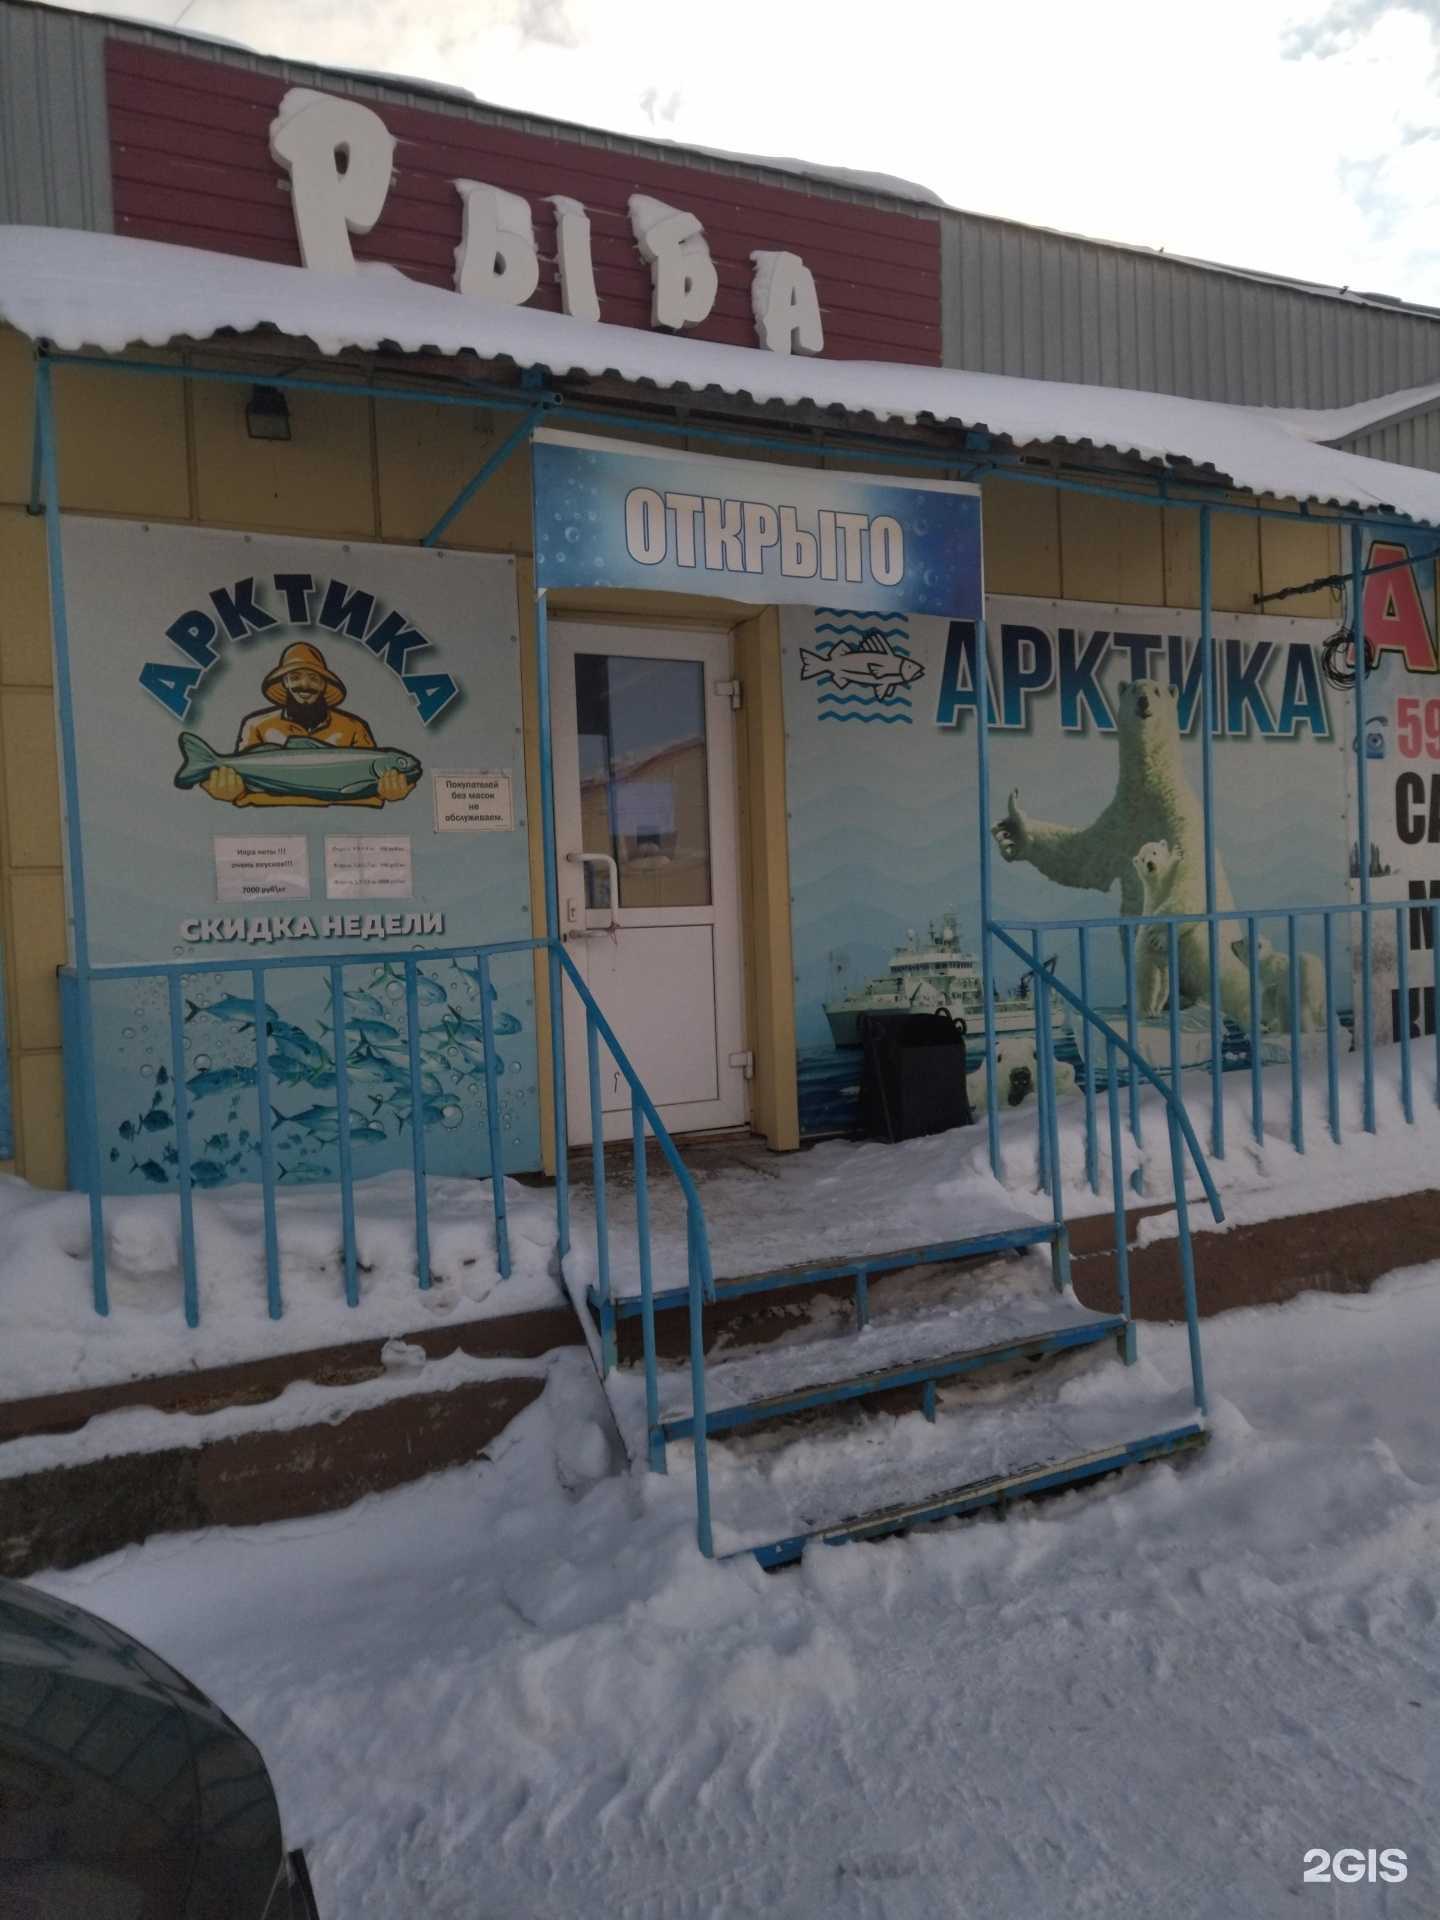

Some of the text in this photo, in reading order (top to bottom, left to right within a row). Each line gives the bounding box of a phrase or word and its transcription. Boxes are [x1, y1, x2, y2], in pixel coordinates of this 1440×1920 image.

[624, 486, 905, 587] ОТКРЫТО
[138, 573, 462, 725] АРКТИКА
[935, 619, 1331, 738] АРКТИКА
[446, 779, 499, 790] Покупателей
[451, 791, 467, 800] без
[469, 803, 480, 811] не
[181, 912, 444, 944] СКИДКА НЕДЕЛИ
